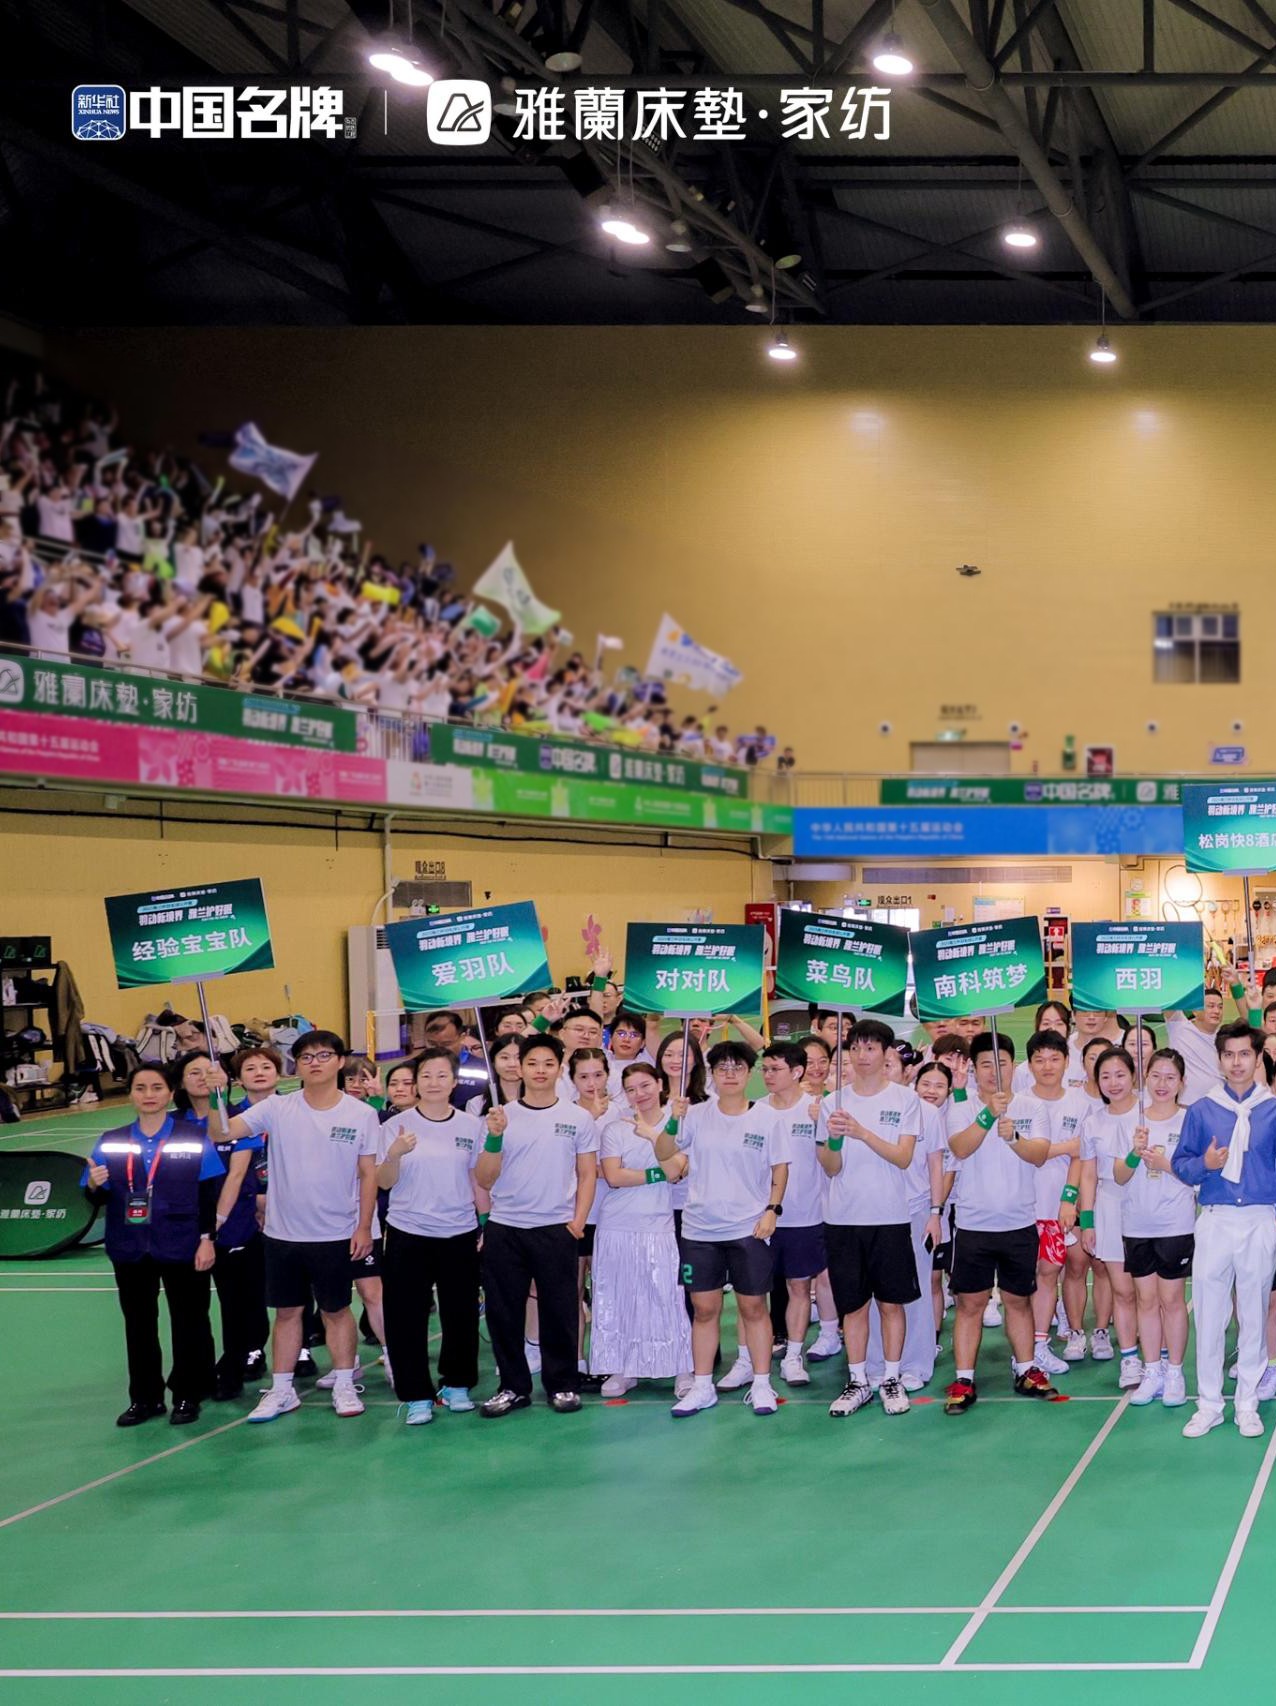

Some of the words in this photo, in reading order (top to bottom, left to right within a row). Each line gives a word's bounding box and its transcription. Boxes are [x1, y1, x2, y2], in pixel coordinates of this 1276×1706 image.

[132, 928, 252, 962] 经验宝宝队
[432, 952, 515, 987] 爱羽队
[656, 968, 730, 992] 对对队
[806, 959, 875, 992] 菜鸟队
[934, 963, 1027, 999] 南科筑梦
[1115, 968, 1161, 990] 西羽
